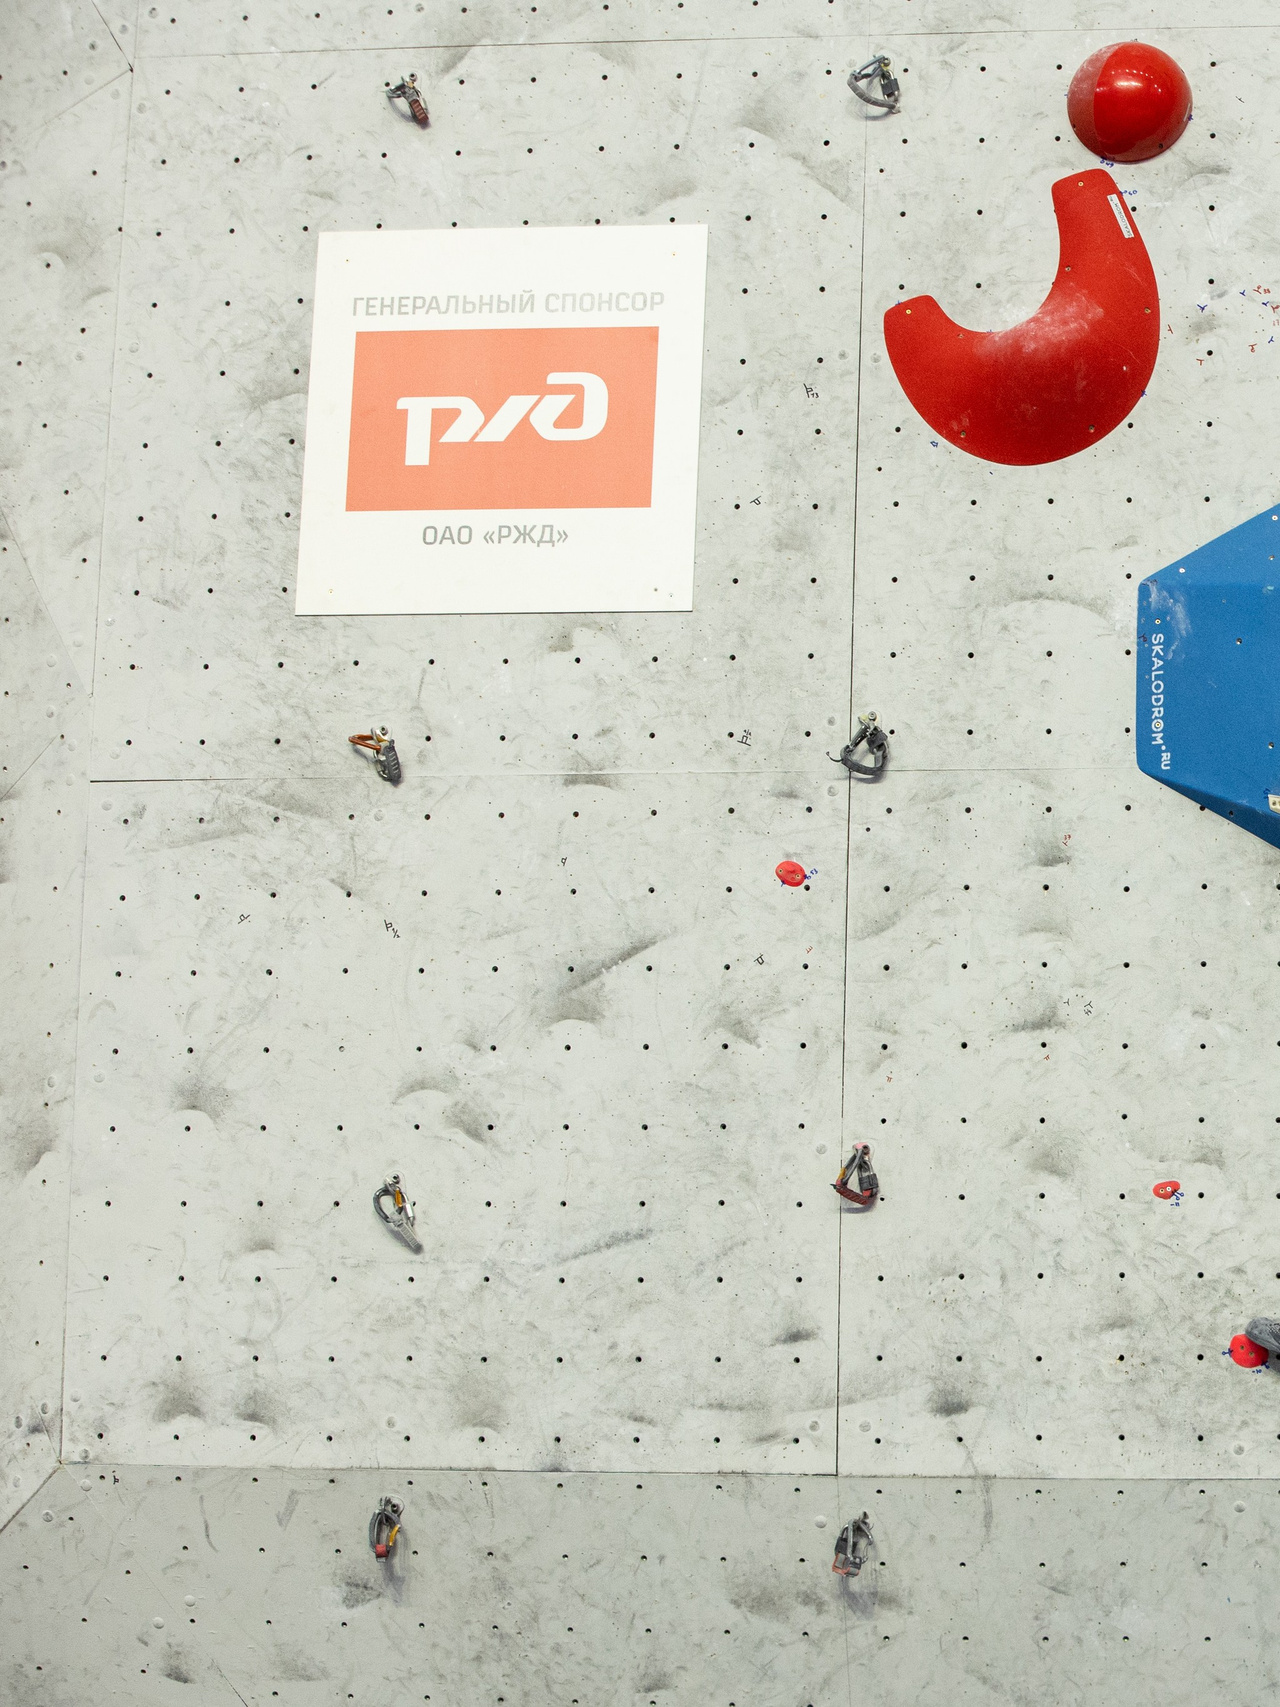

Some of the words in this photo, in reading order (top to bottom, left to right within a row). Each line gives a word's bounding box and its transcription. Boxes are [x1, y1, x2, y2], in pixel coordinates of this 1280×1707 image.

[352, 289, 536, 316] ГЕНЕРАЛЬНЫЙ
[545, 292, 665, 313] СПОНСОР
[422, 525, 473, 545] ОАО
[483, 524, 569, 547] «РЖД»
